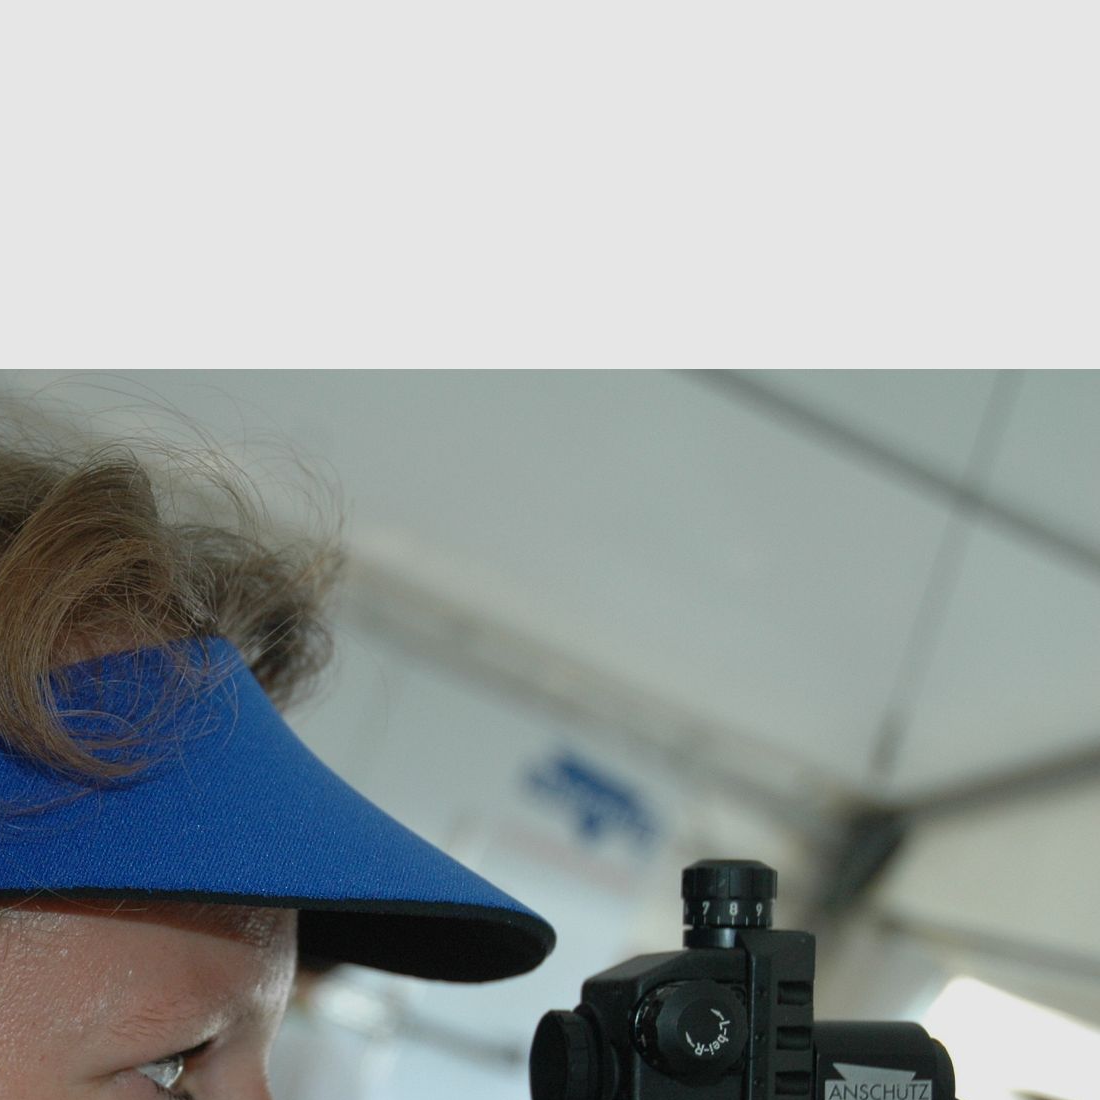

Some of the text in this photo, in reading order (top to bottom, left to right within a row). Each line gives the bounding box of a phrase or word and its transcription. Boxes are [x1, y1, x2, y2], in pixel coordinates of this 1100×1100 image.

[702, 901, 710, 915] 7
[729, 902, 738, 916] 8
[756, 903, 763, 917] 9
